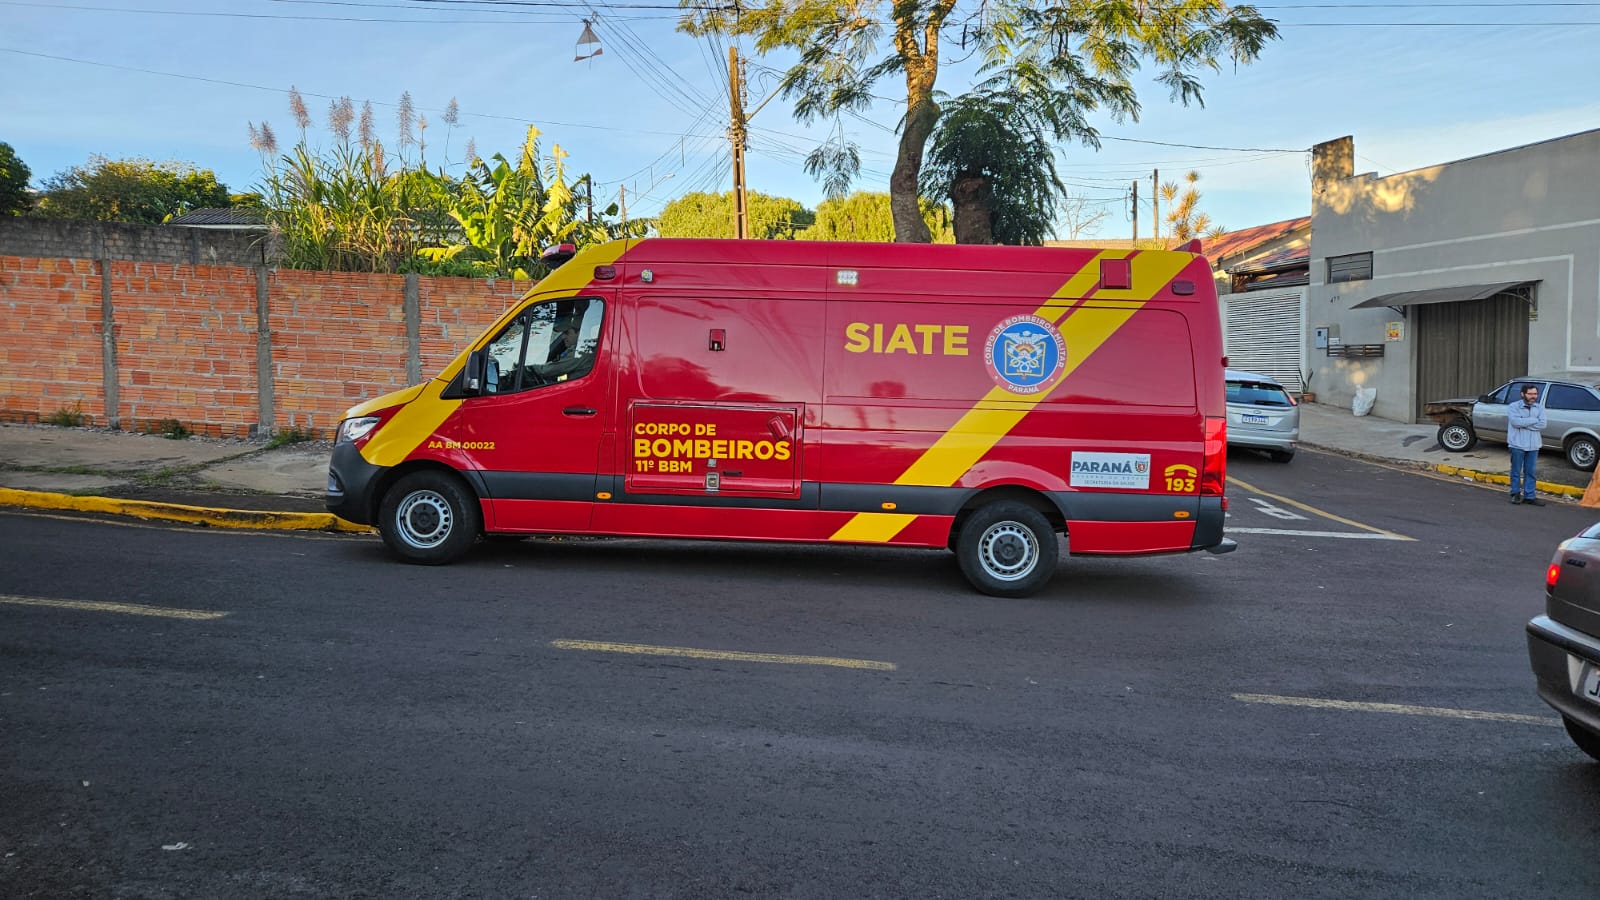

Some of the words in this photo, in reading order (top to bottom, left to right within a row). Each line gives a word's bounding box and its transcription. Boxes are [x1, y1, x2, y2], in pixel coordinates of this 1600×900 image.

[844, 322, 969, 356] SIATE
[985, 334, 995, 365] CORPO
[993, 323, 1005, 334] DE
[1005, 315, 1057, 333] BOMBEIROS
[1054, 333, 1067, 368] MILITAR
[634, 422, 691, 436] CORPO
[695, 423, 717, 436] DE
[427, 440, 443, 449] AA
[445, 440, 461, 449] BM
[463, 441, 496, 450] 00022
[634, 438, 791, 461] BOMBEIROS
[635, 460, 654, 472] 11º
[658, 460, 692, 473] BBM
[1072, 460, 1132, 474] PARANÁ
[1165, 477, 1196, 492] 193
